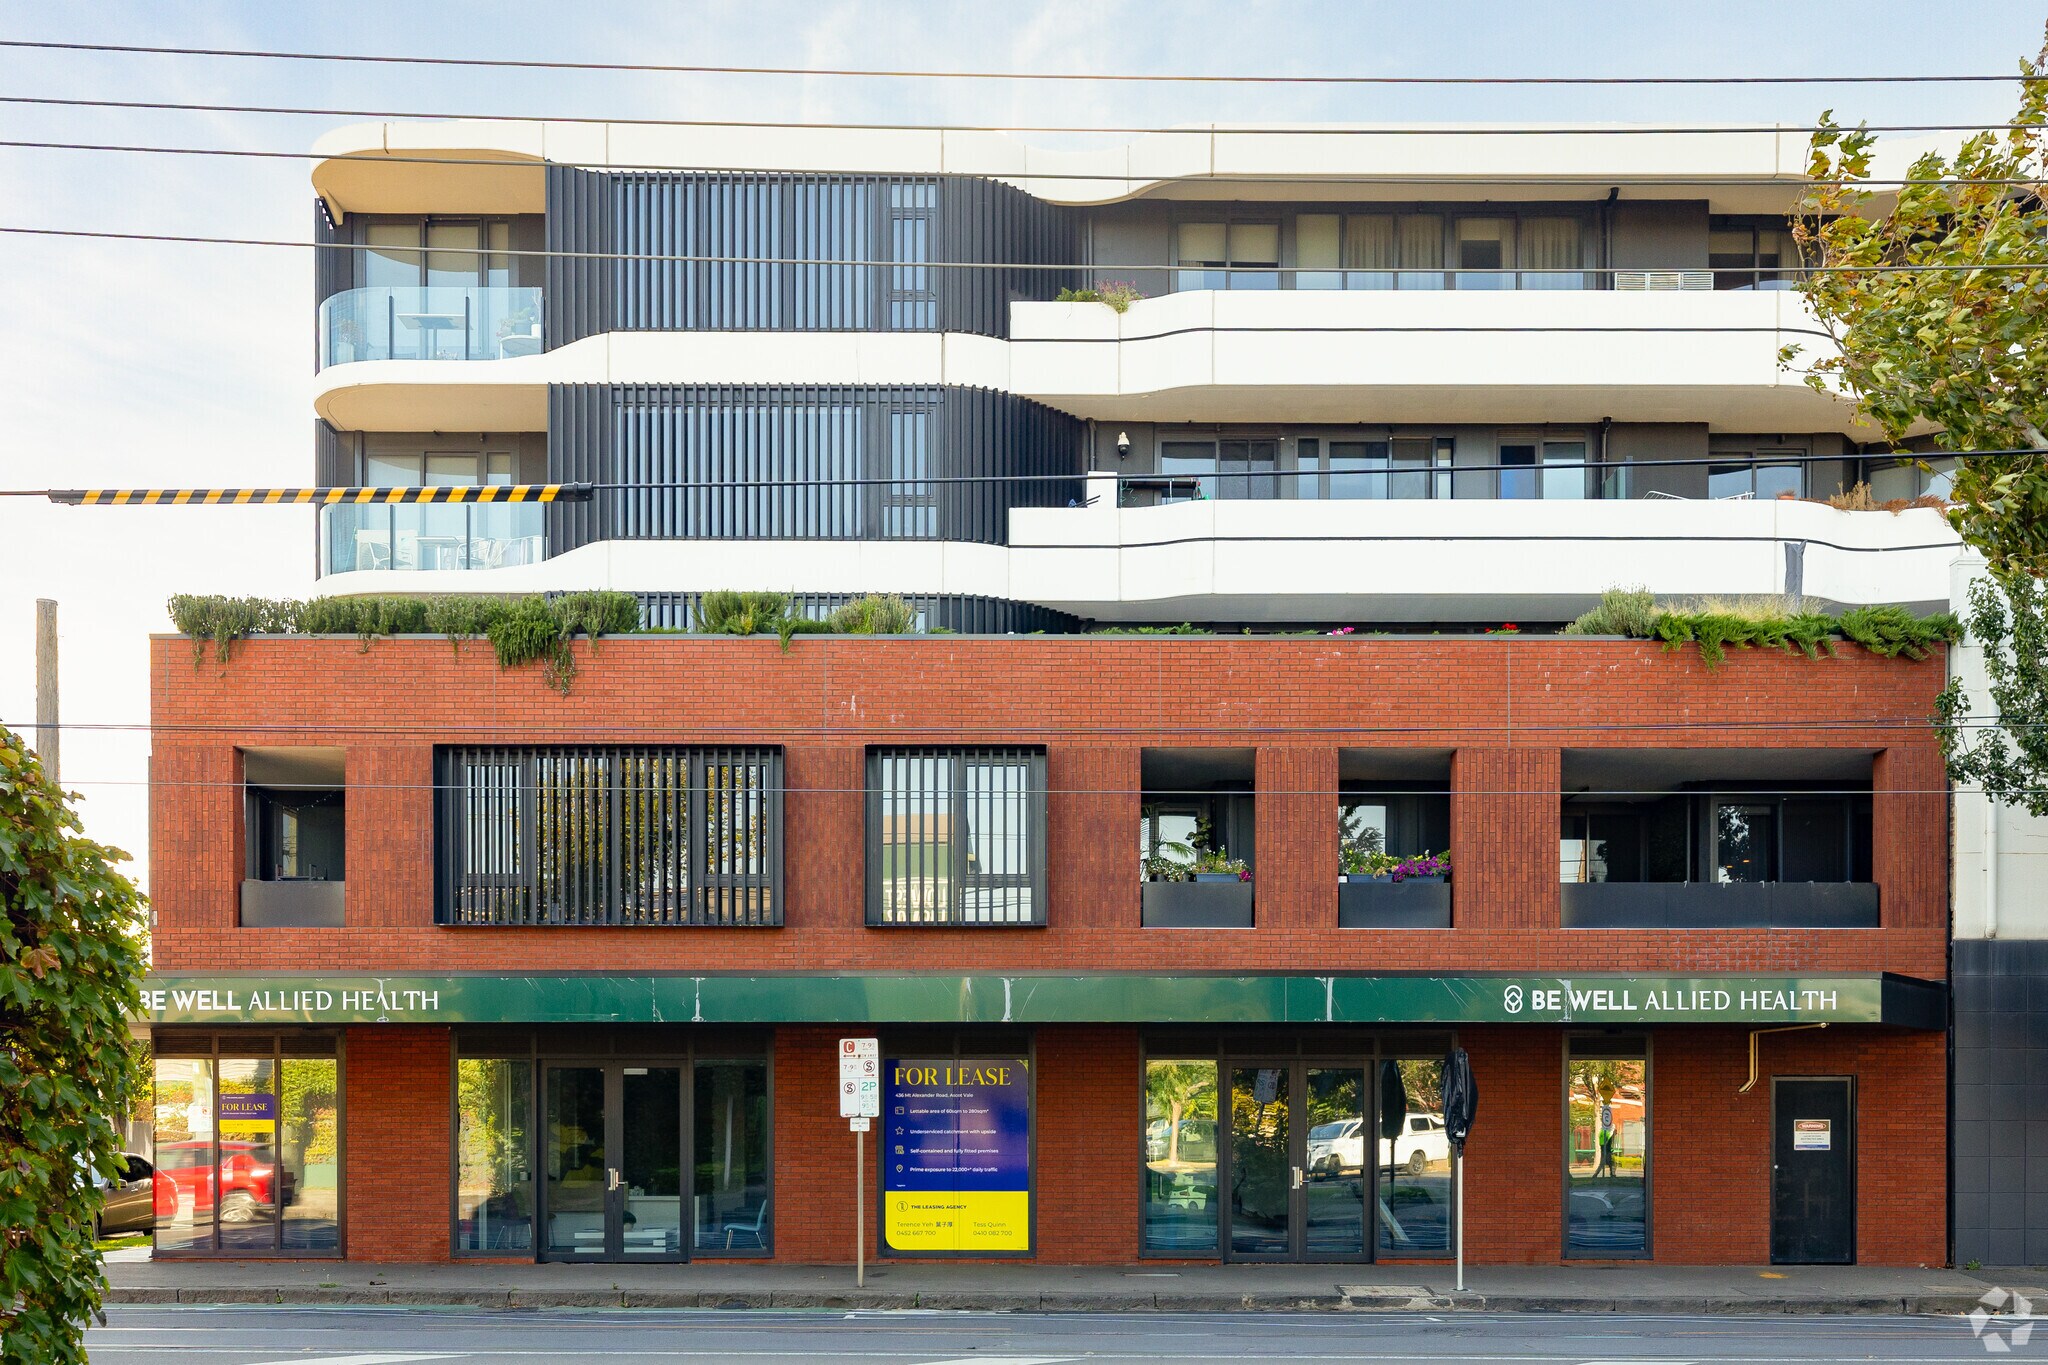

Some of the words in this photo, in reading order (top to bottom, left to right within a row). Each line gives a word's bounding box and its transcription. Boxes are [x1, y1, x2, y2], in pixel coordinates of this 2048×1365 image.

[139, 990, 166, 1011] BE
[171, 990, 242, 1012] WELL
[248, 990, 333, 1011] ALLIED
[342, 990, 439, 1011] HEALTH
[1532, 990, 1561, 1010] BE
[1569, 990, 1637, 1011] WELL
[1644, 990, 1730, 1010] ALLIED
[1740, 990, 1837, 1010] HEALTH
[894, 1067, 938, 1086] FOR
[945, 1067, 1012, 1086] LEASE
[861, 1082, 877, 1092] 2P
[222, 1103, 239, 1111] FOR
[242, 1103, 268, 1111] LEASE
